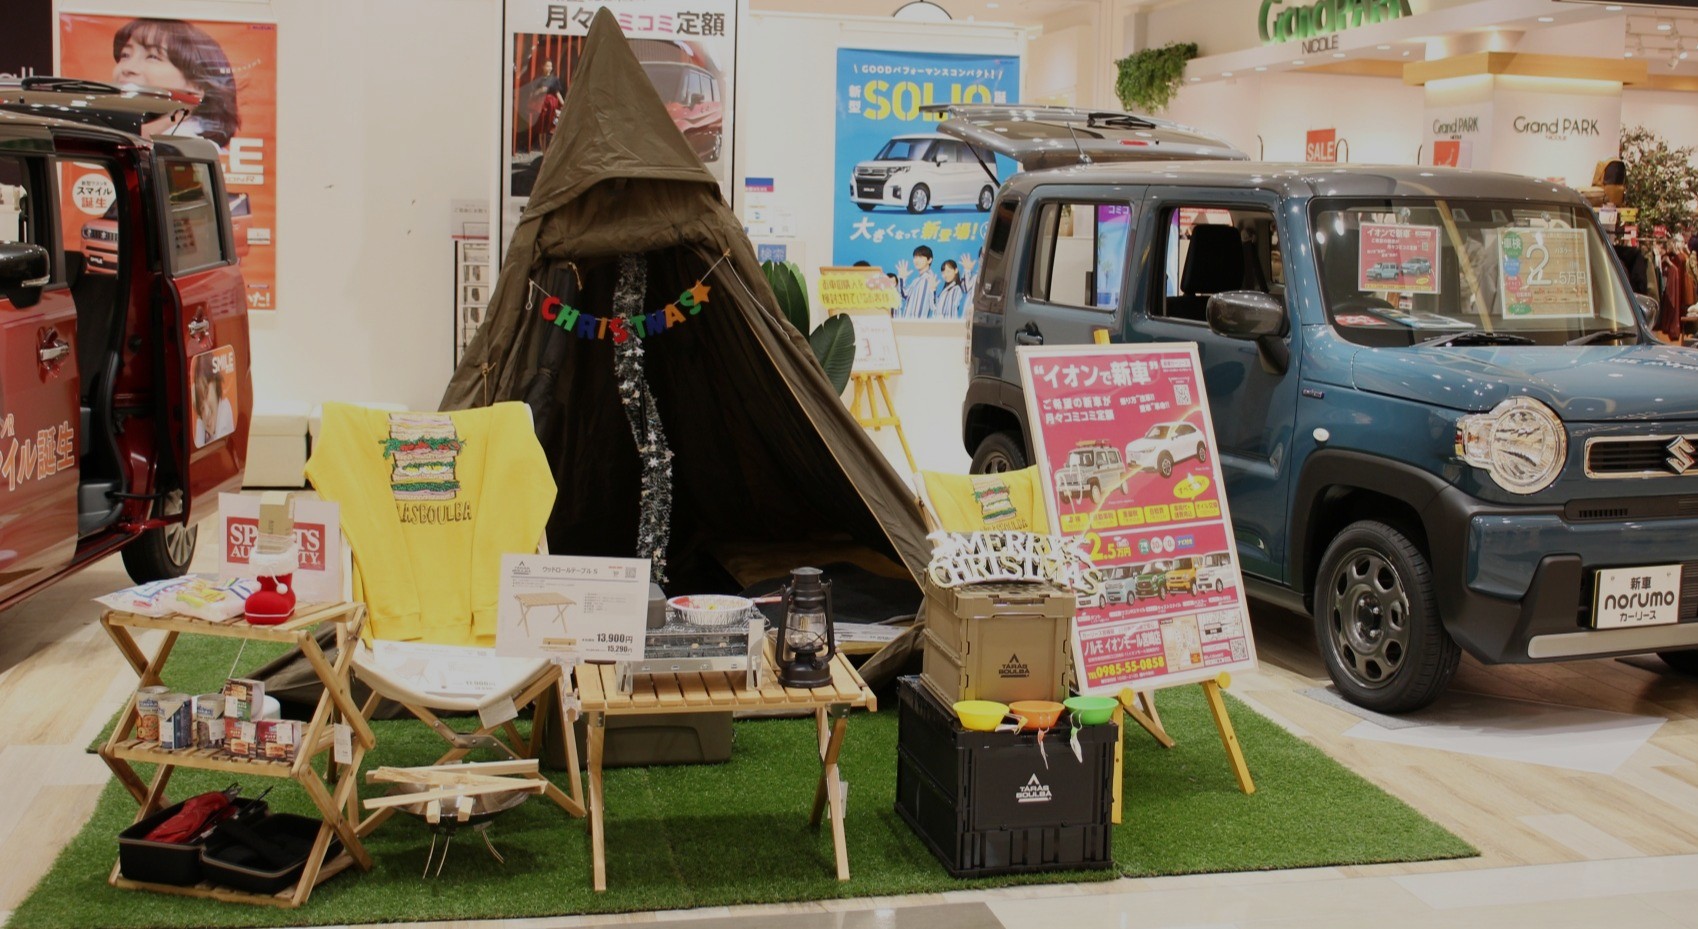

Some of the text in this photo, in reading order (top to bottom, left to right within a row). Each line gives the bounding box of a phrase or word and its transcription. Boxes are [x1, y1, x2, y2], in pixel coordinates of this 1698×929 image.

[545, 5, 725, 37] 月々ミコミ定額
[1302, 35, 1339, 55] NICOLE
[1432, 116, 1479, 135] Grand PARK
[1512, 116, 1600, 136] Grand PARK
[1307, 142, 1335, 161] SALE
[77, 186, 112, 196] スマイル
[81, 196, 107, 208] 誕生
[541, 289, 702, 344] CHRISTMAS
[211, 351, 234, 374] SMILE
[1630, 576, 1652, 590] 新車
[1604, 591, 1675, 610] norumo
[1619, 610, 1657, 623] カーリース
[597, 633, 633, 644] 13,900円
[1016, 791, 1052, 799] BOULBA
